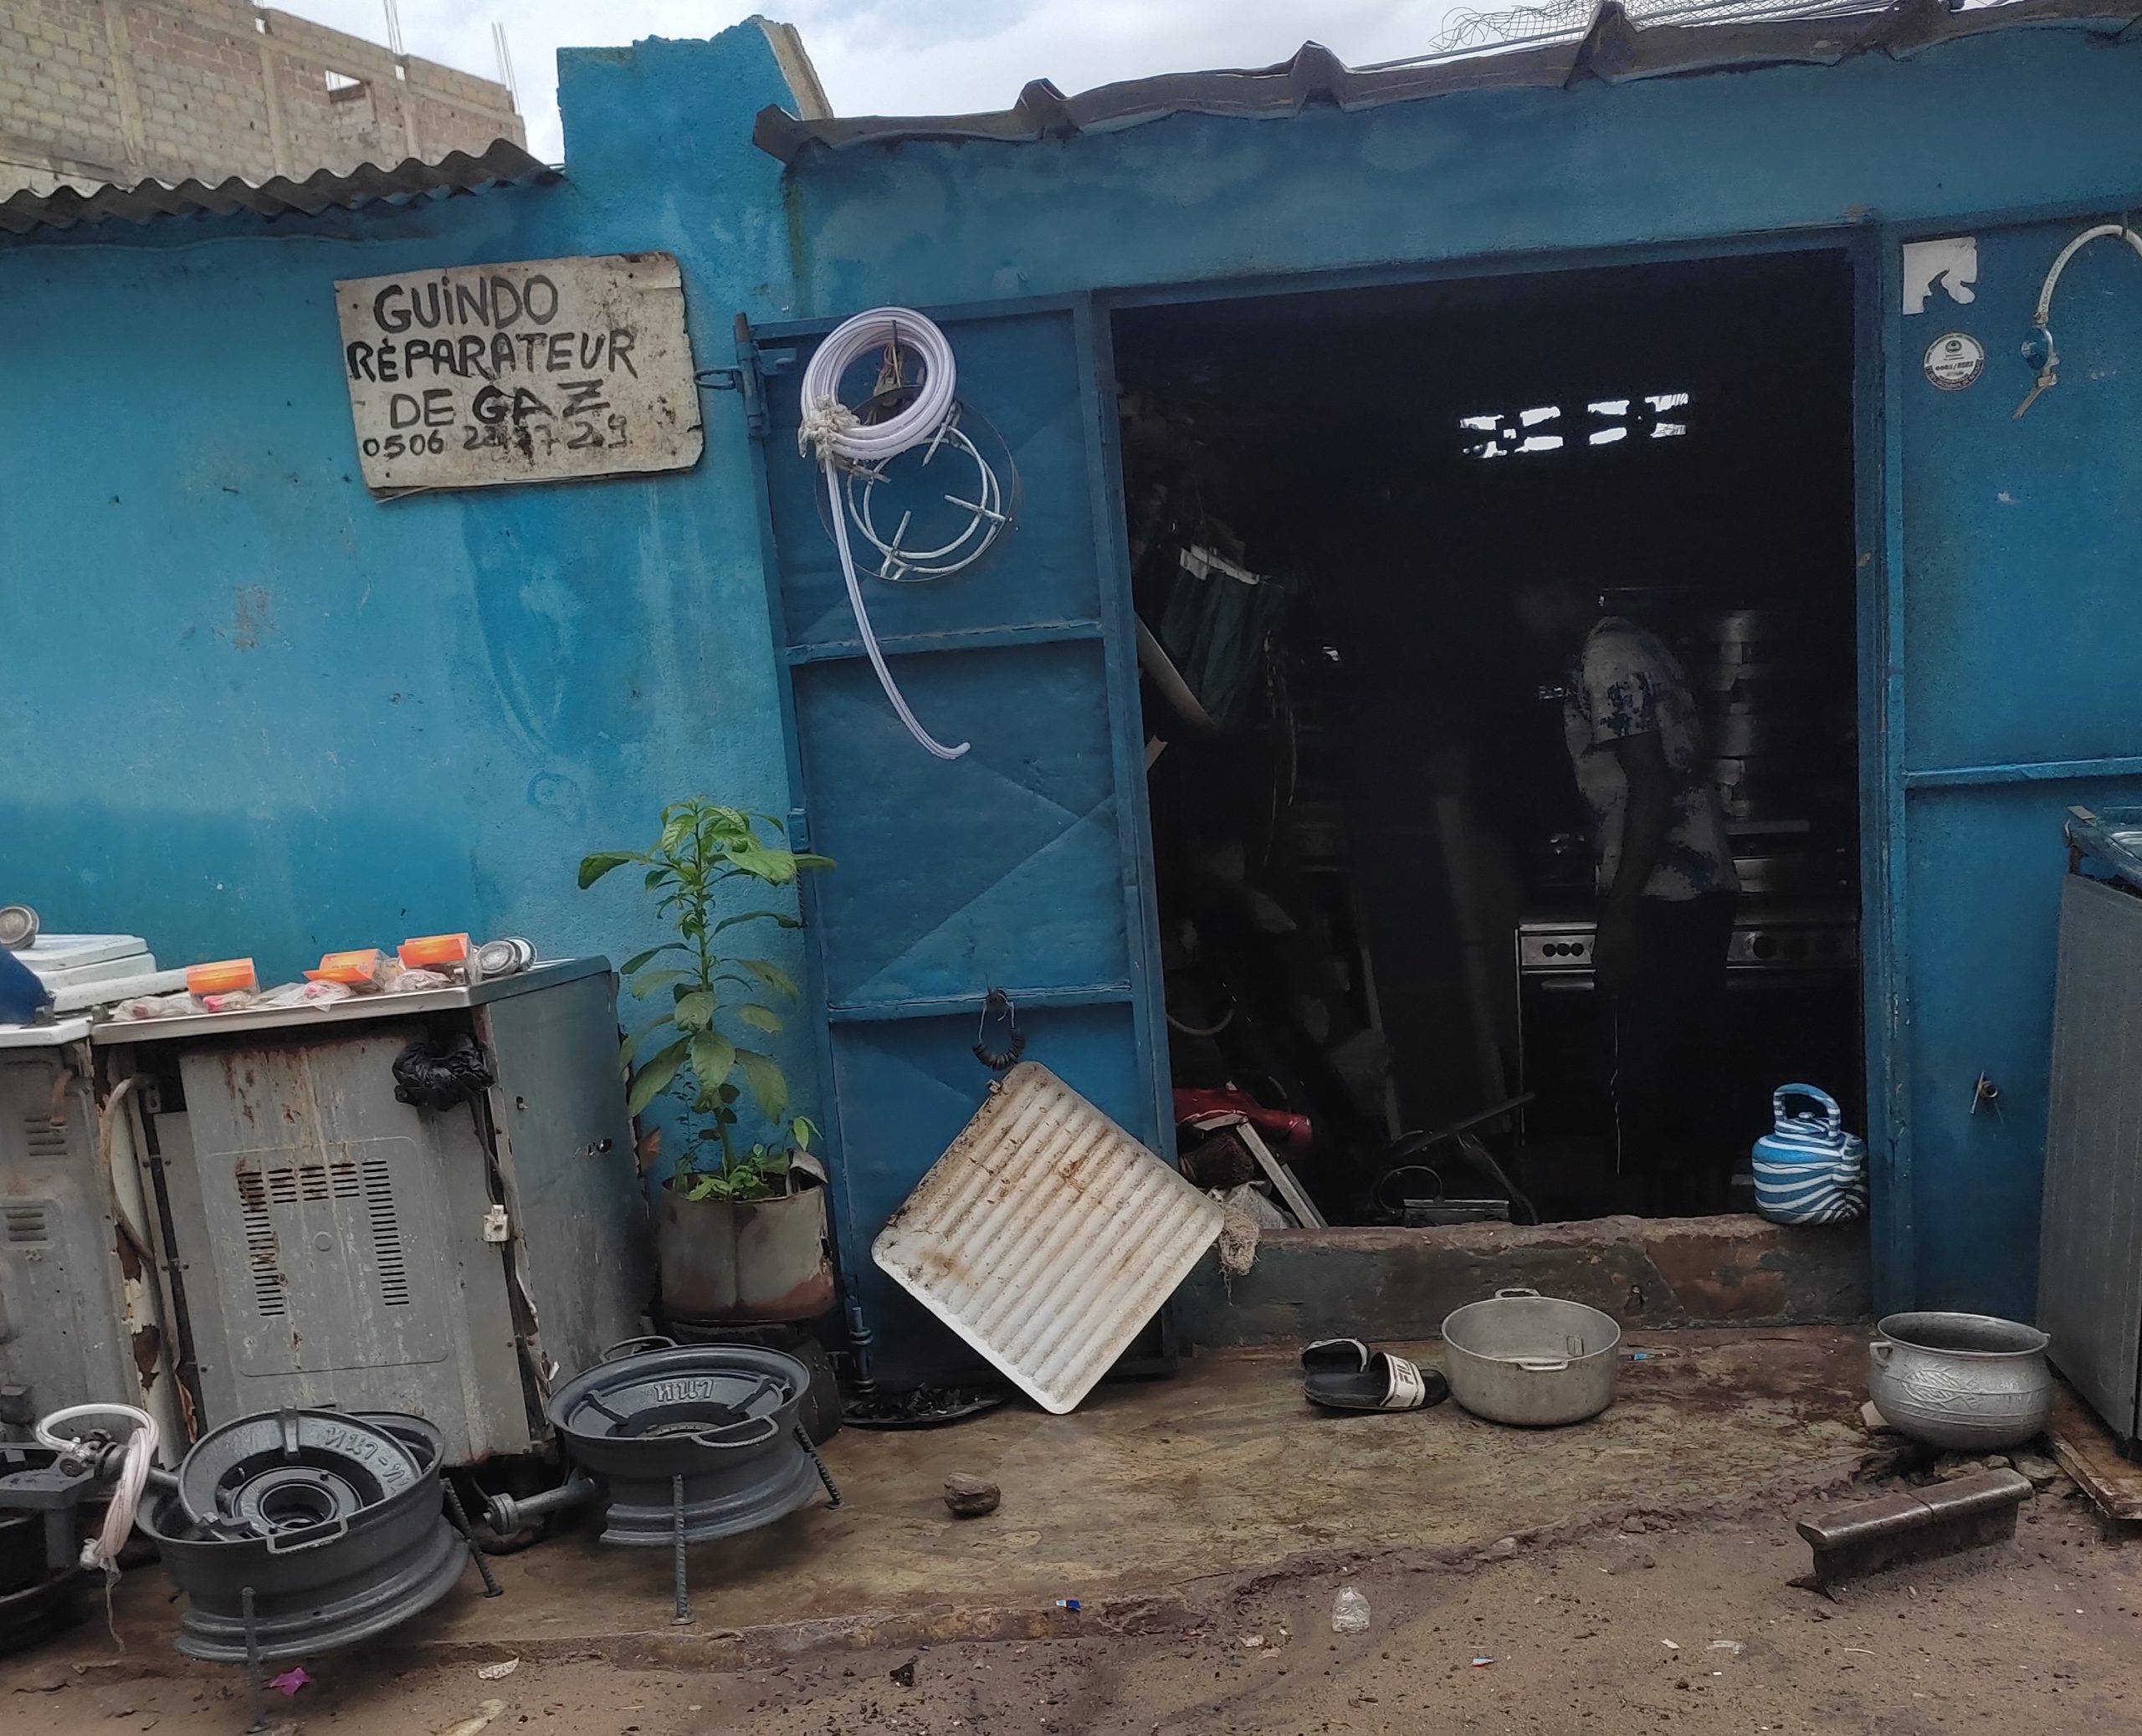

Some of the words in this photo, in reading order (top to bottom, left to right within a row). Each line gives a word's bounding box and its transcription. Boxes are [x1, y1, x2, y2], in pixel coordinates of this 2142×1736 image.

[390, 389, 455, 429] DE
[472, 379, 611, 425] GAZ
[363, 430, 444, 459] 0506
